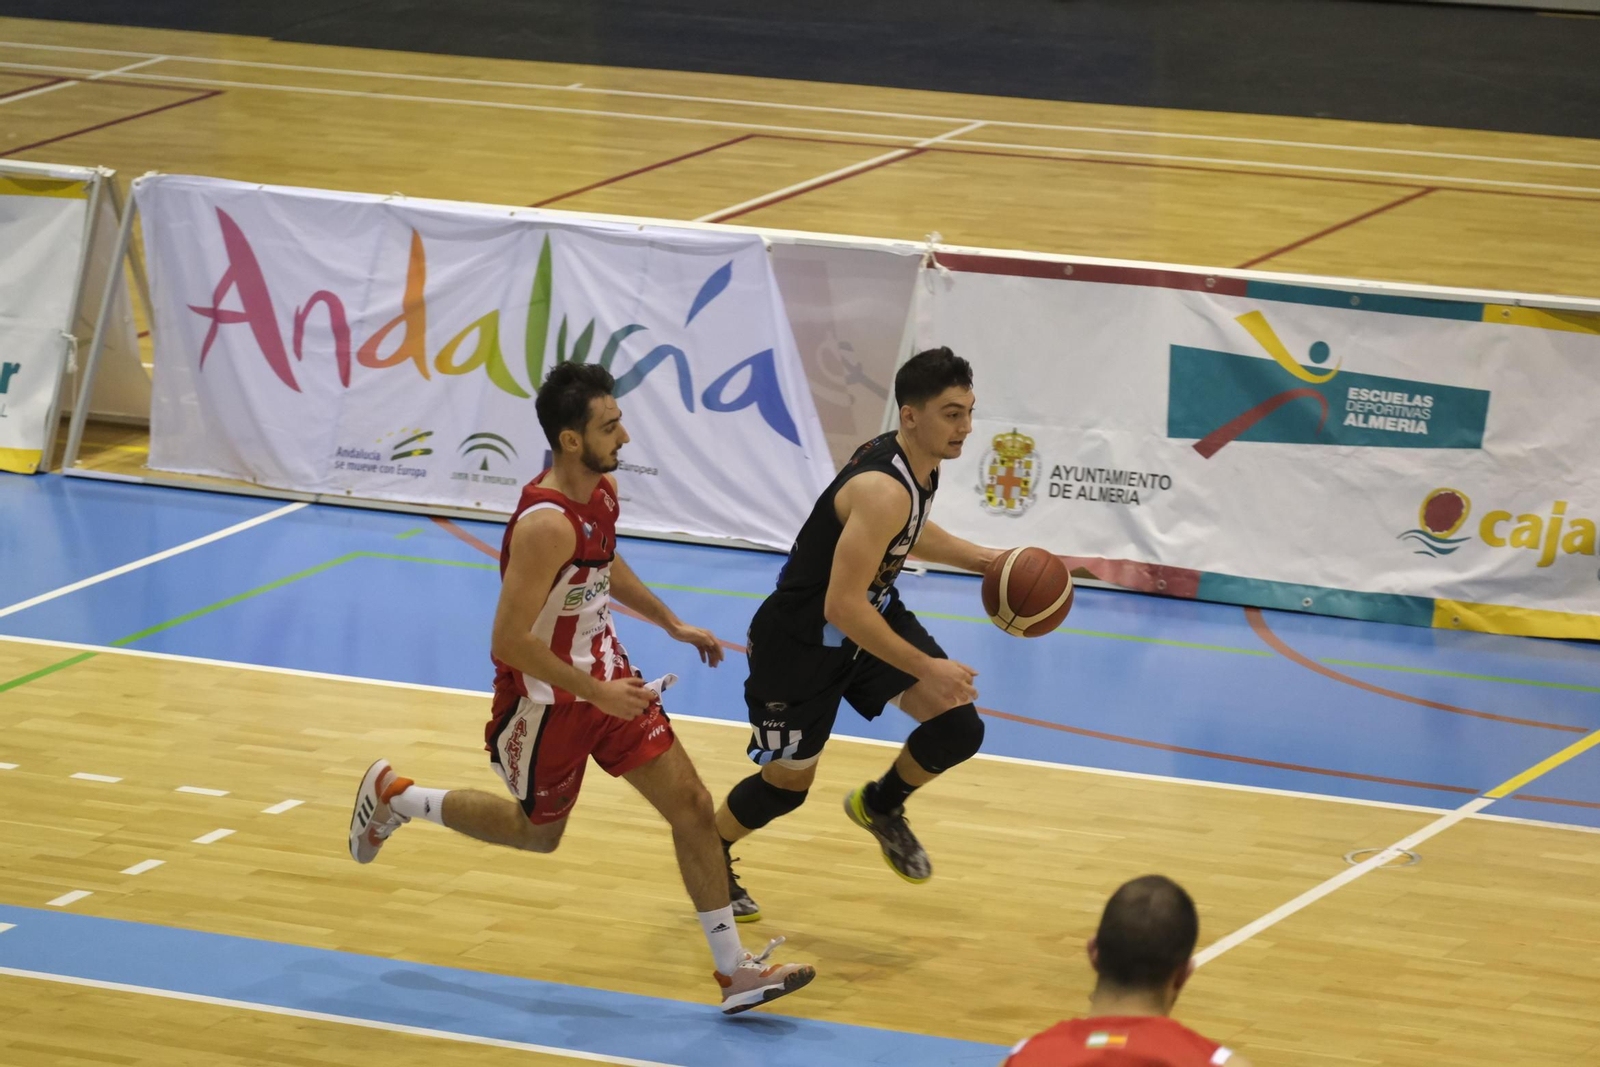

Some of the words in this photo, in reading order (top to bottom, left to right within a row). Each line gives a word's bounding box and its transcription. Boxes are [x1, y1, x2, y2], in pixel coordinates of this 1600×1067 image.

[1347, 387, 1434, 408] ESCUELAS
[1345, 400, 1431, 420] DEPORTIVAS
[1343, 412, 1428, 435] ALMERIA
[334, 460, 345, 470] se
[347, 462, 377, 473] mueve
[379, 465, 395, 475] con
[397, 464, 427, 479] Europa
[618, 460, 658, 476] Europea
[1050, 465, 1172, 491] AYUNTAMIENTO
[1049, 483, 1072, 499] DE
[1075, 486, 1140, 506] ALMERIA
